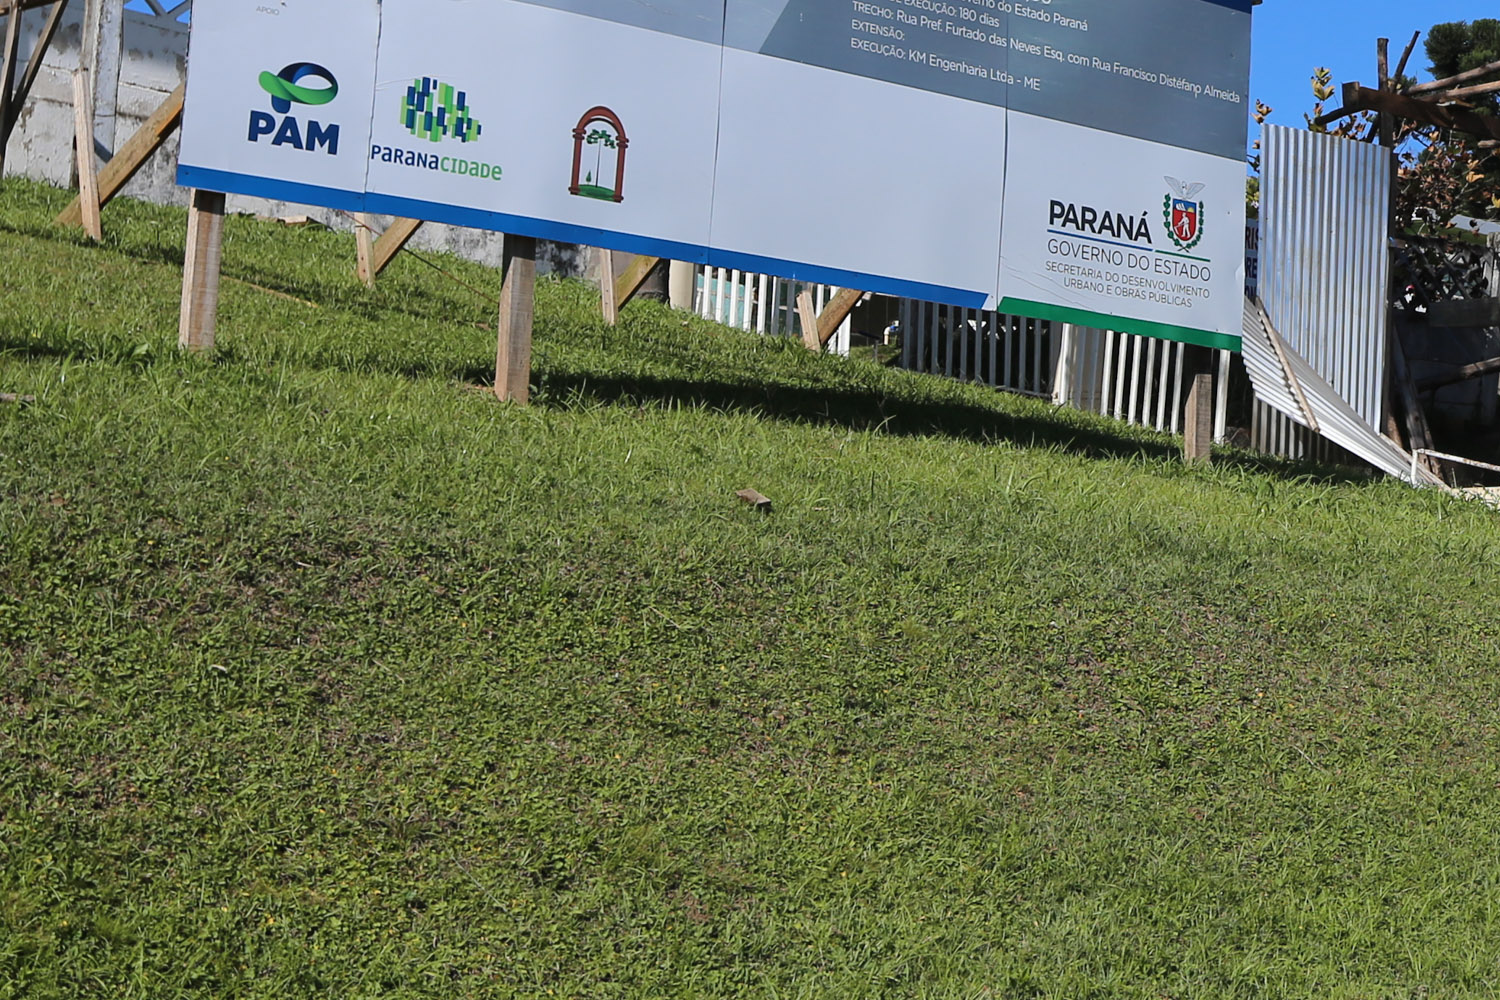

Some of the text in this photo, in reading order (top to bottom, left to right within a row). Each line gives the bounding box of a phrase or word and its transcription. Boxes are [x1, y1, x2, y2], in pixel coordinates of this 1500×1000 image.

[256, 5, 279, 16] APOIO
[959, 7, 976, 22] 180
[979, 12, 1000, 28] dias
[998, 0, 1012, 13] do
[1015, 3, 1050, 23] Estado
[1053, 12, 1088, 31] Paraná
[852, 19, 905, 41] EXTENSÃO:
[851, 38, 906, 60] EXECUÇÃO:
[909, 49, 926, 64] KM
[929, 53, 987, 79] Engenharia
[990, 68, 1014, 85] Ltda
[1024, 76, 1041, 91] ME
[852, 1, 893, 20] TRECHO:
[897, 10, 917, 26] Rua
[920, 16, 942, 32] Pref.
[946, 22, 986, 42] Furtado
[989, 33, 1007, 47] das
[1010, 38, 1041, 56] Neves
[1044, 46, 1064, 62] Esq.
[1067, 52, 1089, 67] com
[1092, 56, 1111, 72] Rua
[1113, 62, 1157, 83] Francisco
[1204, 84, 1240, 104] Almeida
[248, 110, 340, 155] PAM
[1050, 200, 1152, 244] PARANÁ
[1048, 238, 1211, 281] GOVERNO DO ESTADO
[1046, 261, 1210, 298] SECRETARIA DO DESENVOLVIMENTO
[1064, 277, 1192, 308] URBANO E OBRAS PÚBLICAS
